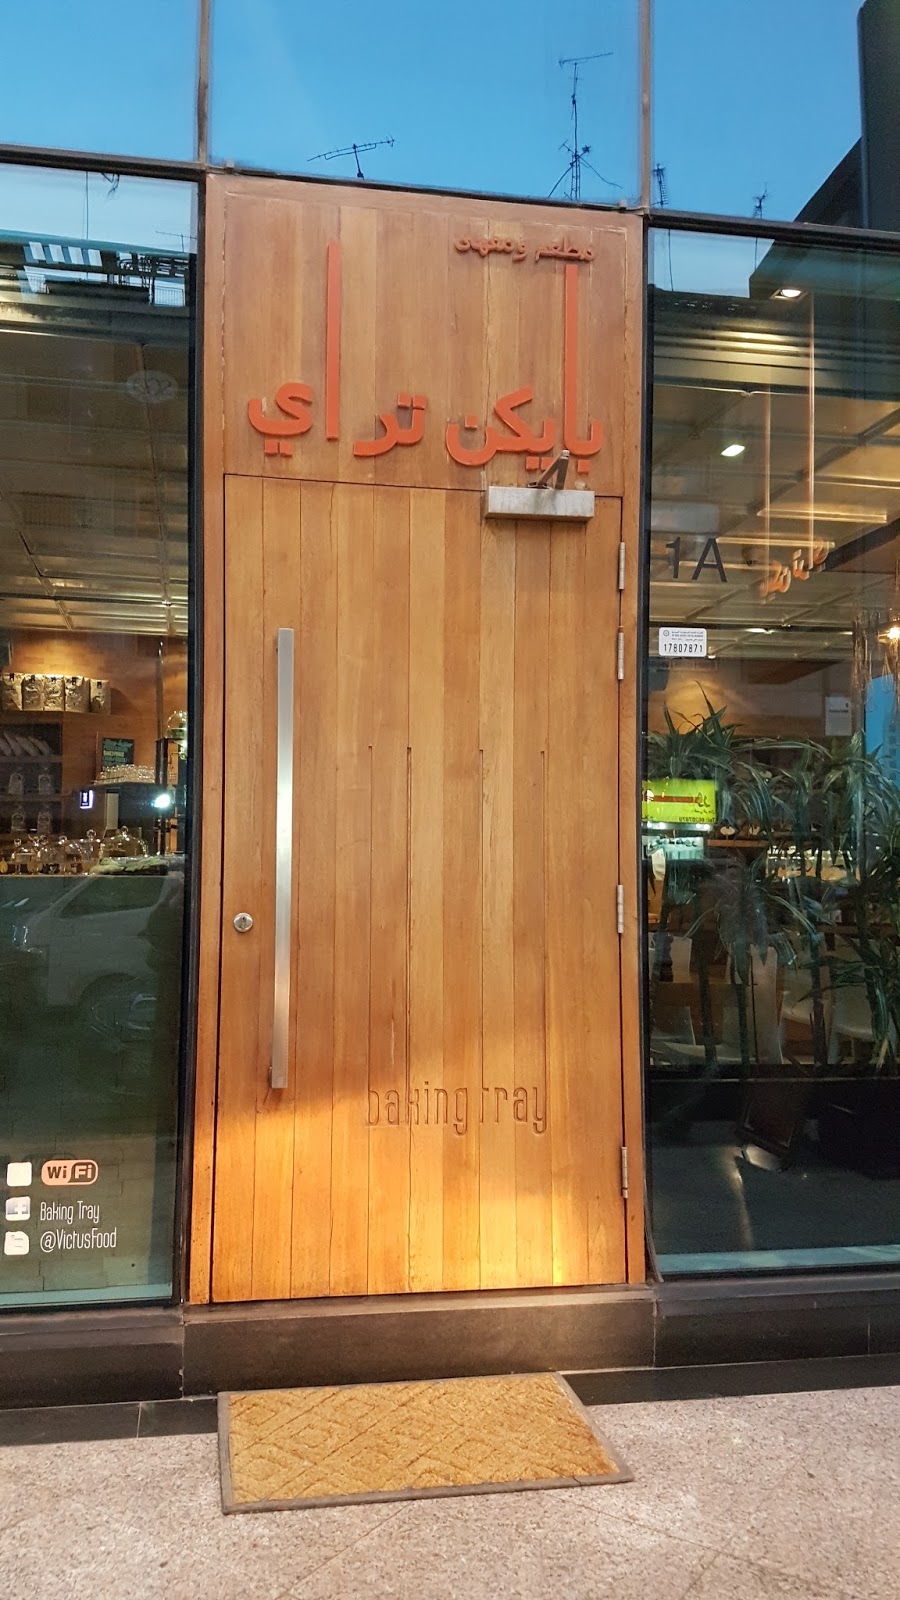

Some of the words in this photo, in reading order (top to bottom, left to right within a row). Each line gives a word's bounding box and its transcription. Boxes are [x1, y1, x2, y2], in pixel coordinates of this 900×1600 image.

[535, 236, 594, 262] مطعم
[248, 240, 428, 457] تراي
[446, 264, 603, 474] بايكن
[666, 537, 727, 582] 1A
[663, 643, 703, 653] 17807871
[367, 1080, 468, 1136] baking
[40, 1201, 74, 1224] Baking
[77, 1200, 100, 1223] Tray
[40, 1227, 117, 1253] @VictusFood
